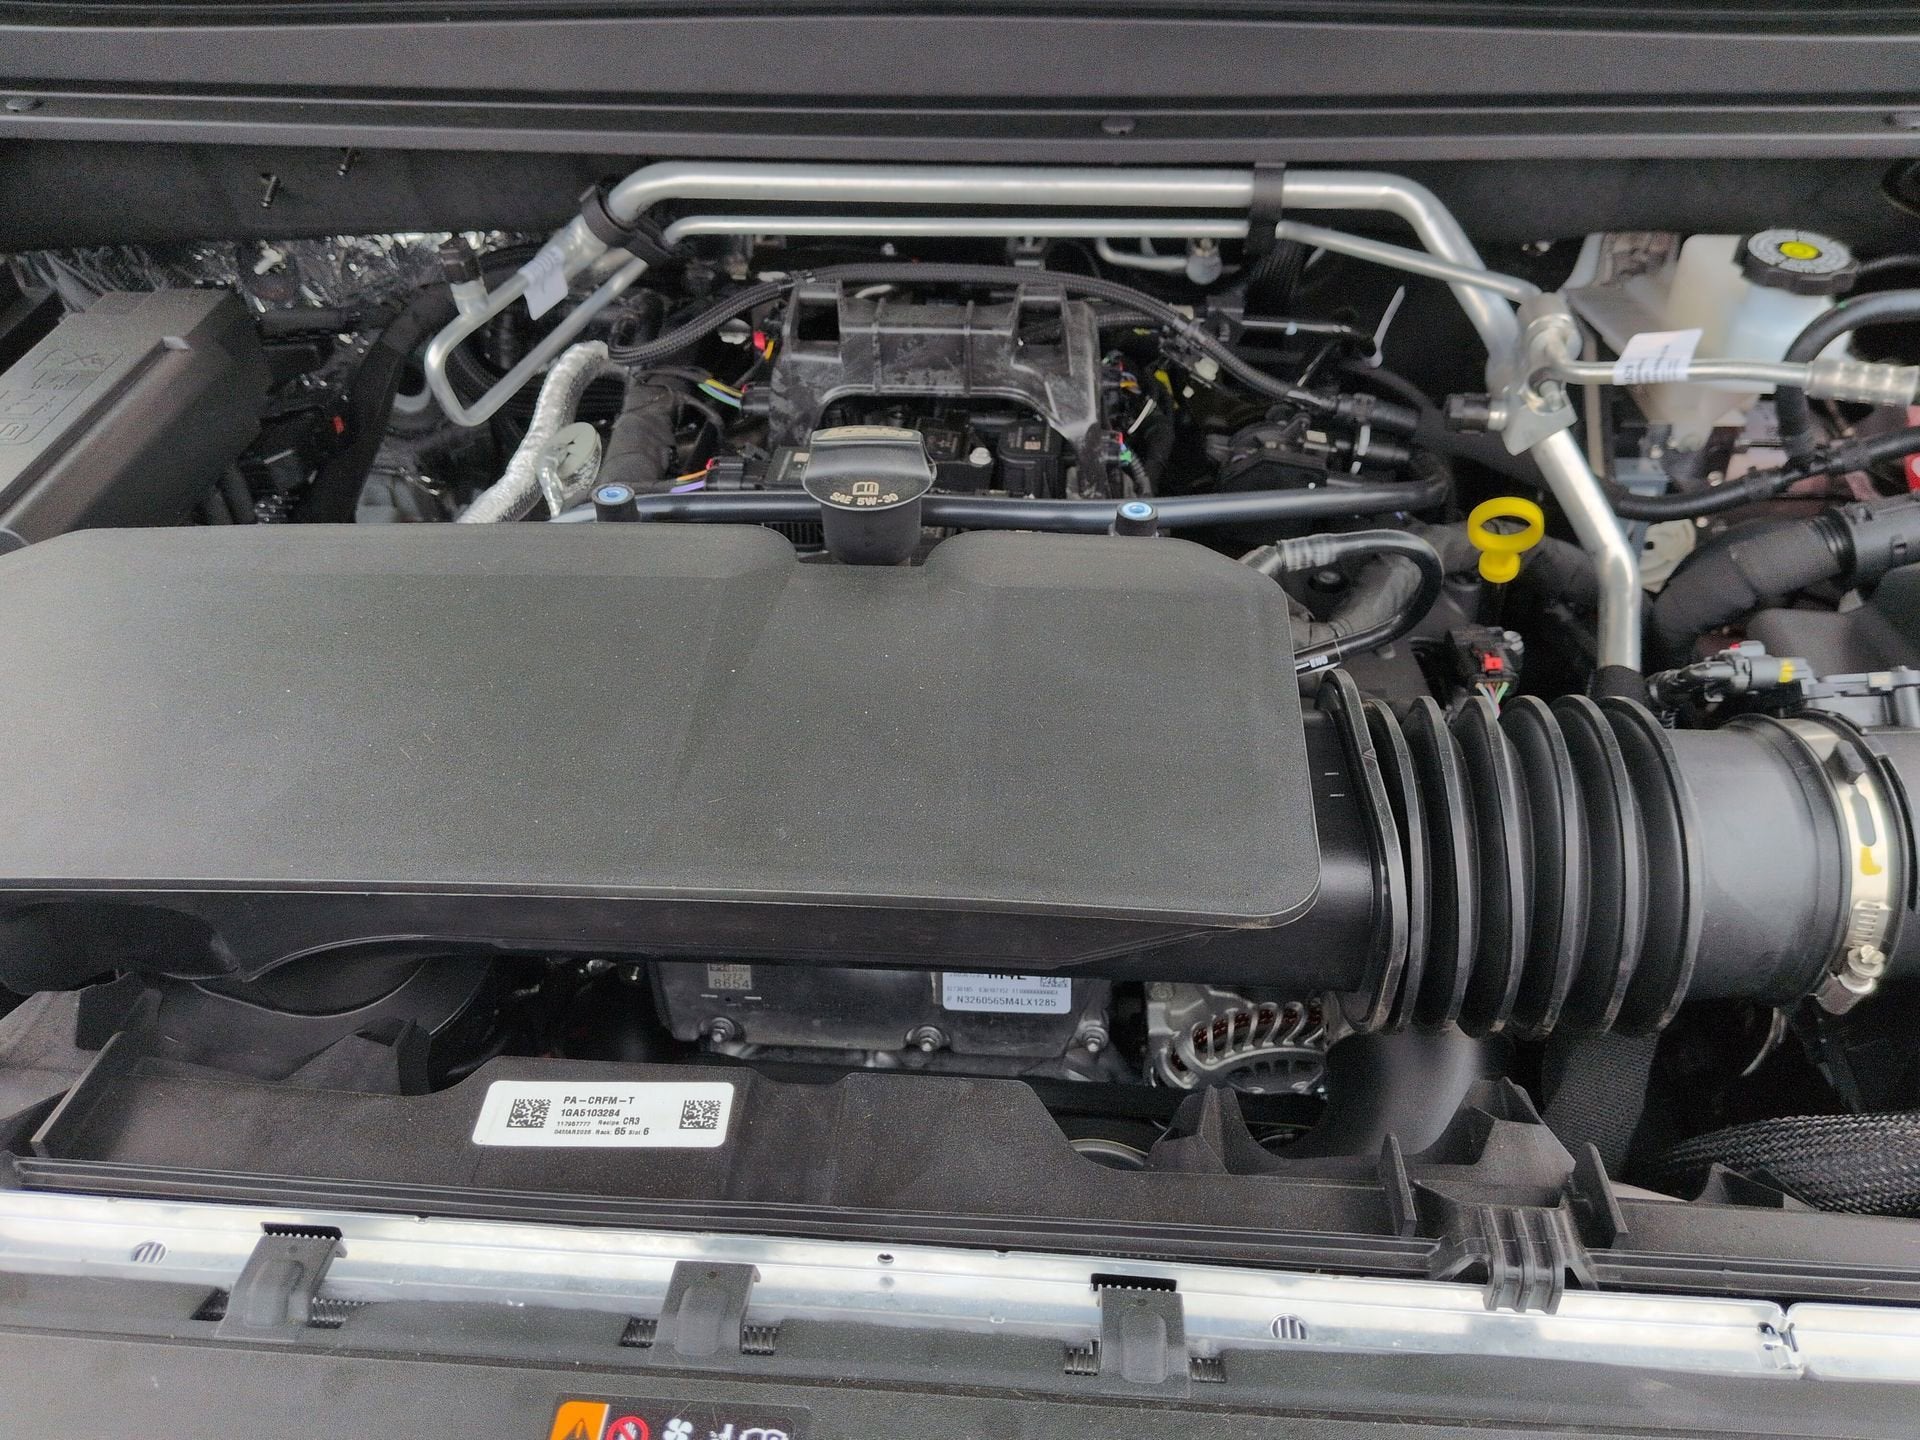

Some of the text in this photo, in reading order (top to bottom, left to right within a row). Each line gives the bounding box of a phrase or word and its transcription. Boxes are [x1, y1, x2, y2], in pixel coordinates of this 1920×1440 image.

[829, 491, 899, 506] SAE 5W-30
[560, 1108, 621, 1117] 1GA5103284
[622, 1117, 640, 1126] CR3
[642, 1127, 650, 1136] 6
